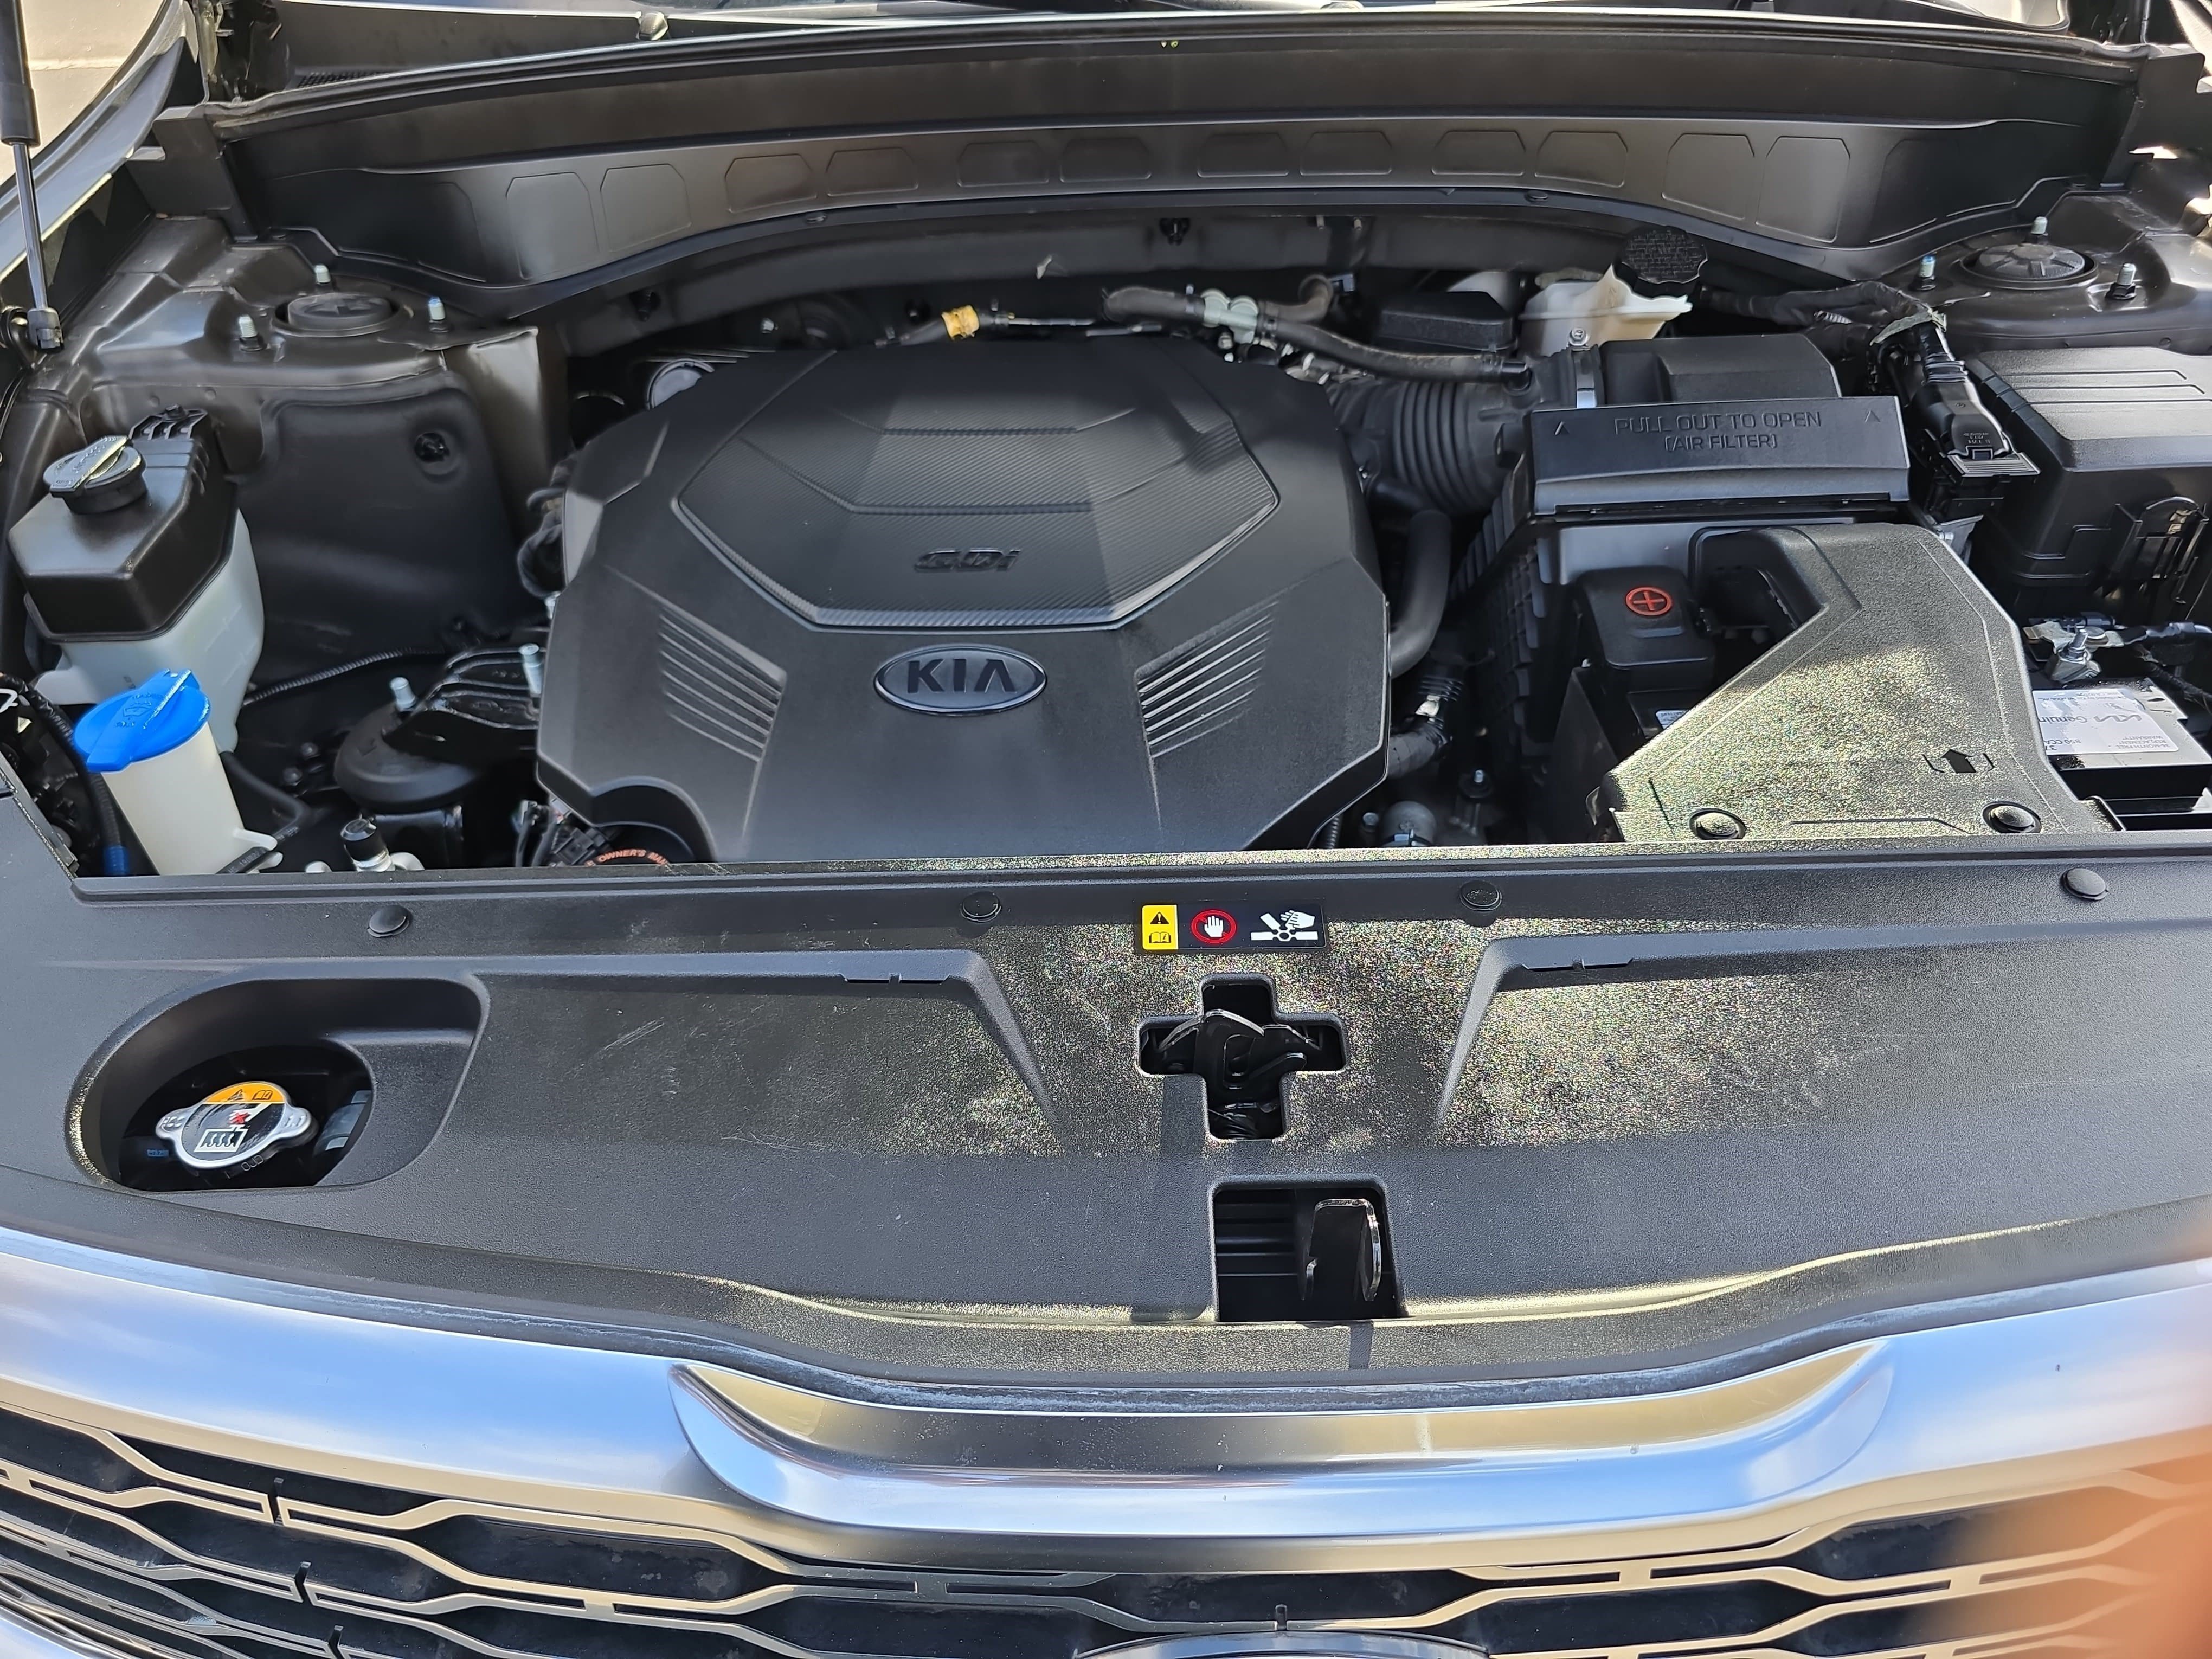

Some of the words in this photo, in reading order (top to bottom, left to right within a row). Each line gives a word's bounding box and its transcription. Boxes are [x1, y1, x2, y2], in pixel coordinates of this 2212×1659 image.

[1614, 416, 1672, 435] PULL
[1676, 414, 1722, 431] OUT
[1728, 413, 1759, 430] TO
[1761, 411, 1822, 428] OPEN
[907, 658, 1017, 694] KIA
[2037, 716, 2087, 724] Genuin
[598, 848, 647, 863] OWNER'S
[241, 1154, 265, 1172] OJD
